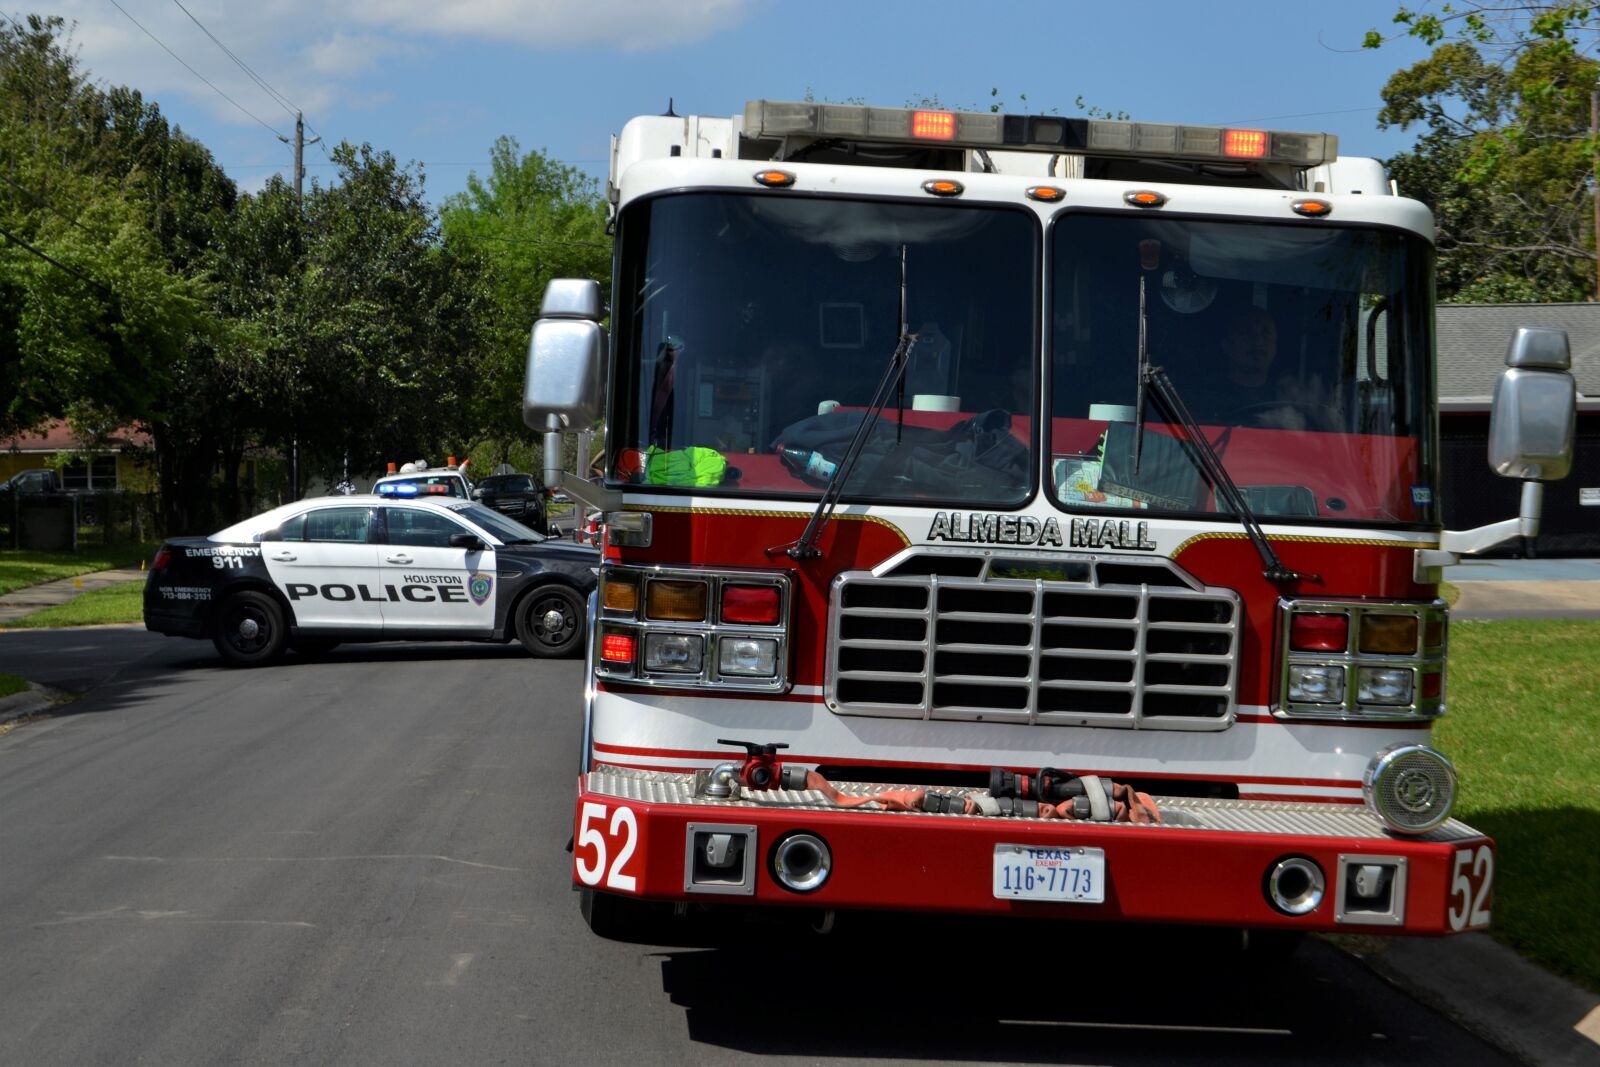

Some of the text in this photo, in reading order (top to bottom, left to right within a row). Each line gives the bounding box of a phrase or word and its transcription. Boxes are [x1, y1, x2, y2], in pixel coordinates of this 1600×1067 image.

[927, 511, 1157, 550] ALMEDA MALL
[185, 547, 260, 557] EMERGENCY
[212, 556, 244, 569] 911
[404, 574, 462, 584] HOUSTON
[285, 583, 469, 603] POLICE
[576, 802, 638, 892] 52
[1027, 848, 1071, 861] TEXAS
[1449, 845, 1493, 932] 52
